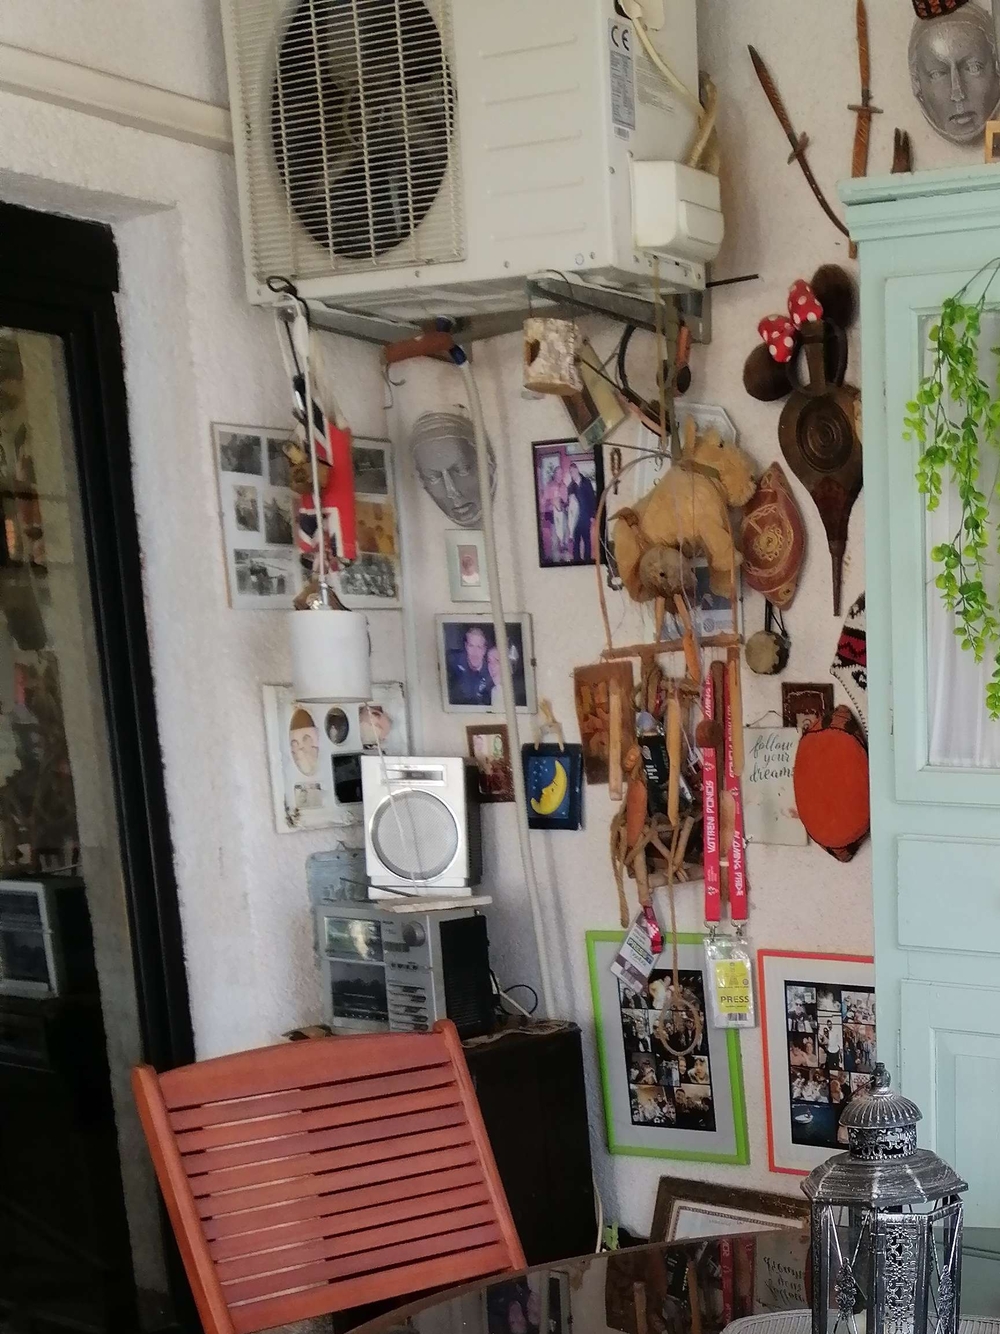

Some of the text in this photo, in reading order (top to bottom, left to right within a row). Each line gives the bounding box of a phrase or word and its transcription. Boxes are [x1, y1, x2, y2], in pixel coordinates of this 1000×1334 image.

[749, 732, 794, 759] follow
[762, 752, 790, 769] your
[720, 995, 750, 1004] PRESS
